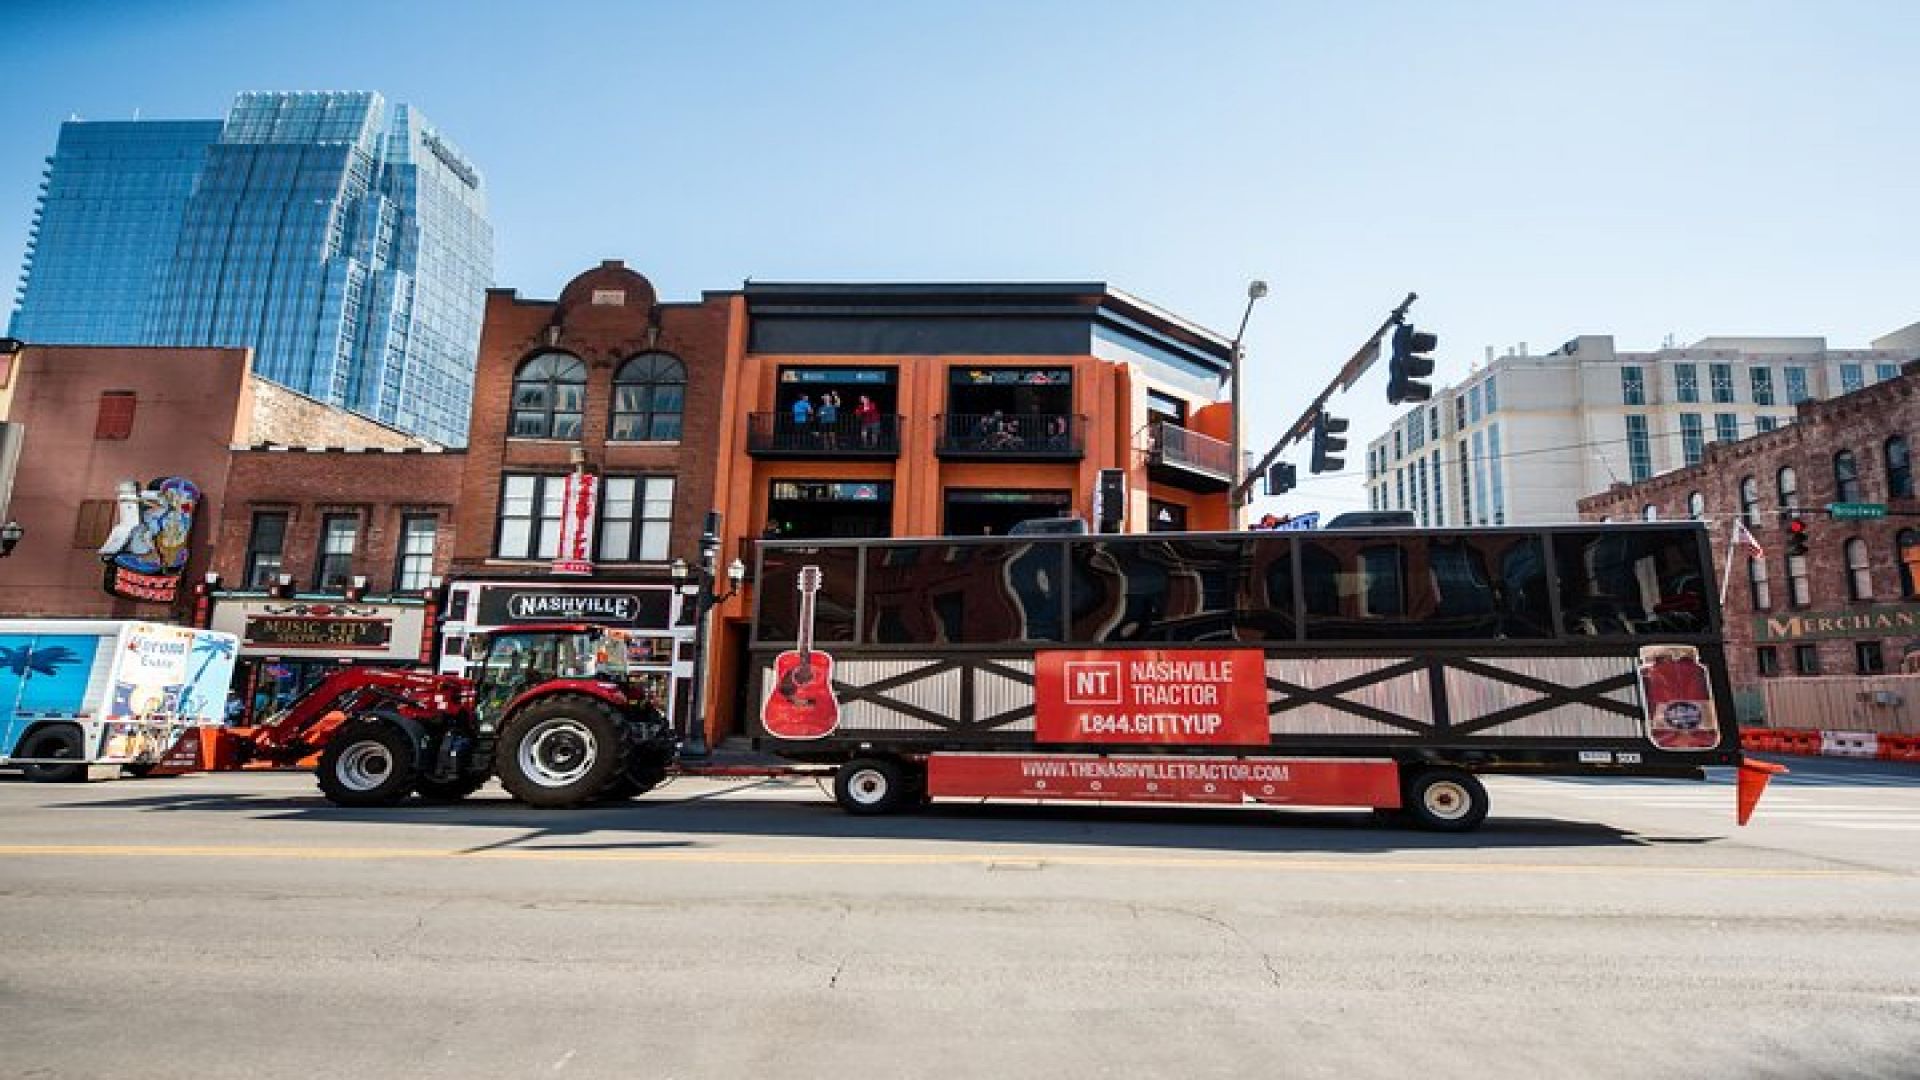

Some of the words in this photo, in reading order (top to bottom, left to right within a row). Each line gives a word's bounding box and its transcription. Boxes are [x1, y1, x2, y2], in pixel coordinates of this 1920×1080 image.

[520, 597, 628, 617] NASHVILLE
[264, 620, 320, 633] MUSIC
[328, 622, 371, 635] CITY
[1767, 612, 1913, 638] MERCHAN
[1130, 661, 1233, 682] NASHVILLE
[1076, 671, 1110, 695] NT
[1131, 683, 1218, 705] TRACTOR
[1021, 761, 1289, 781] WWW.THENASHVILLETRACTOR.COM
